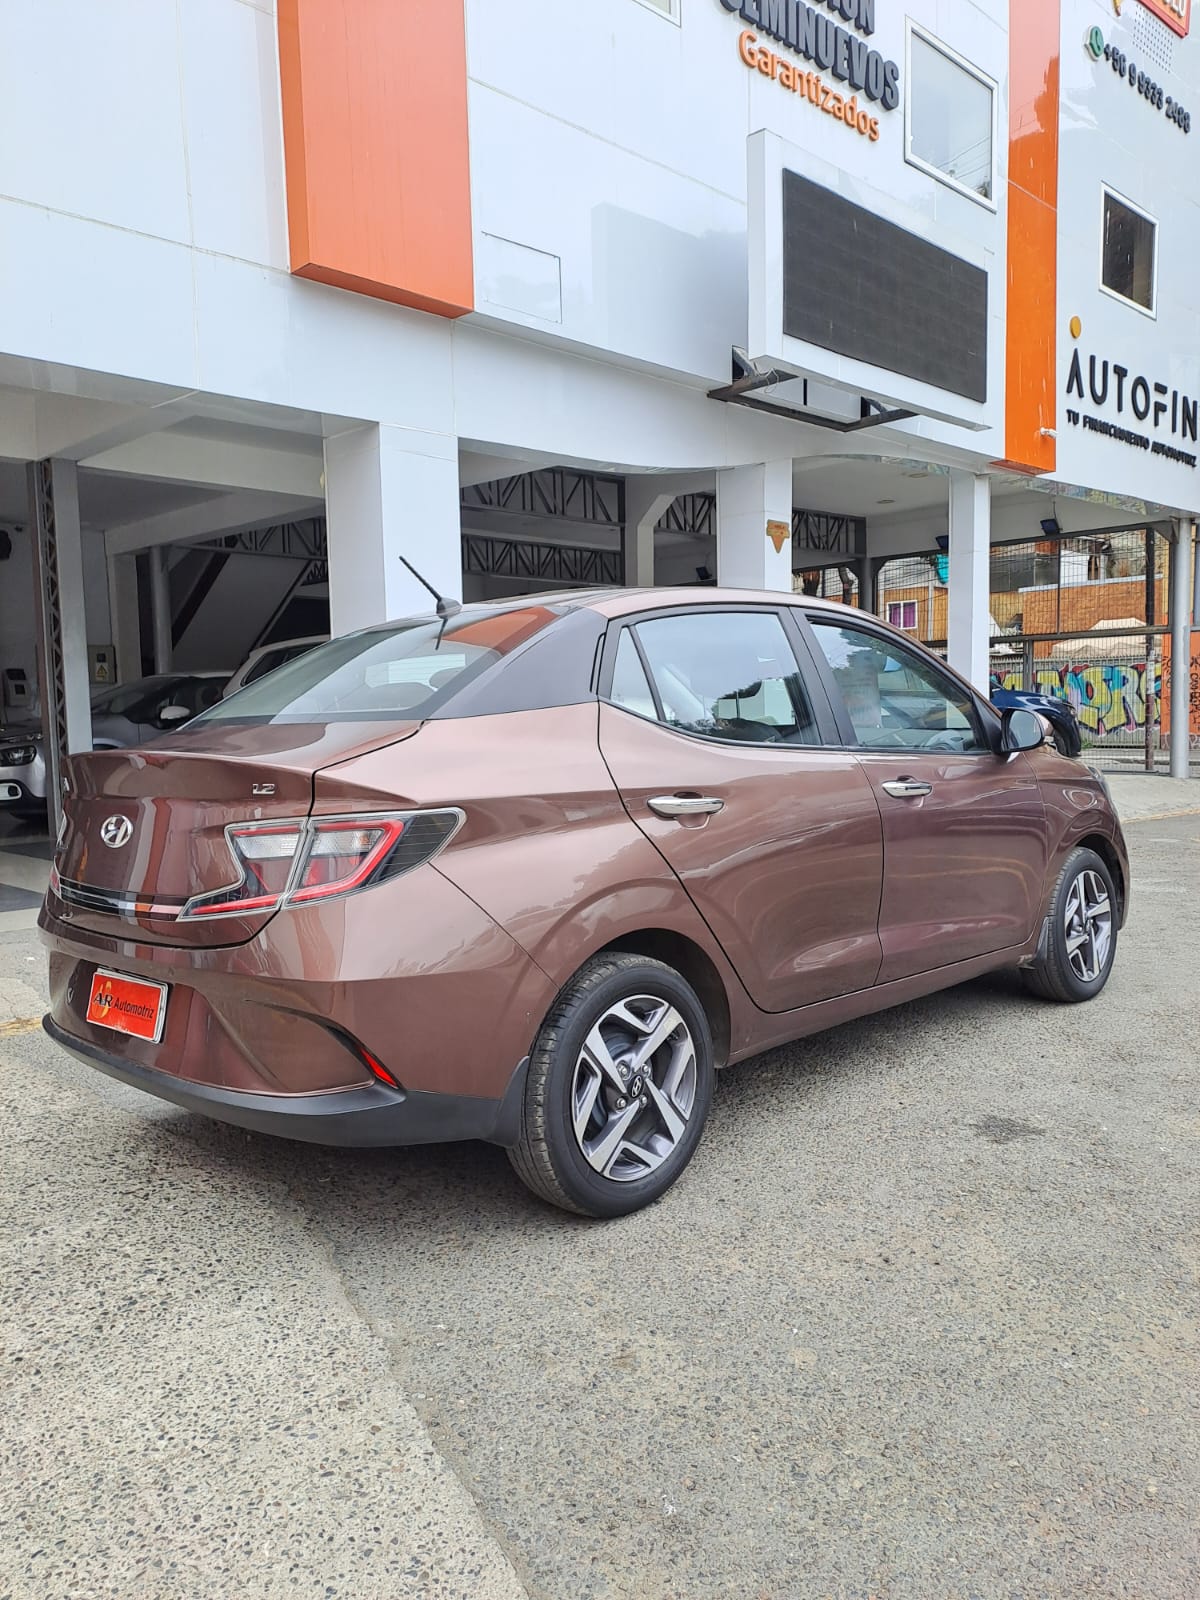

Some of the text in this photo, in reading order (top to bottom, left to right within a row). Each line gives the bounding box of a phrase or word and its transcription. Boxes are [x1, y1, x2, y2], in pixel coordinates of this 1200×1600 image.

[720, 0, 899, 110] MINUEVOS
[738, 30, 880, 142] Garantizados
[1066, 347, 1198, 442] AUTOFIN
[1066, 409, 1079, 425] TU
[114, 997, 154, 1019] Automotriz
